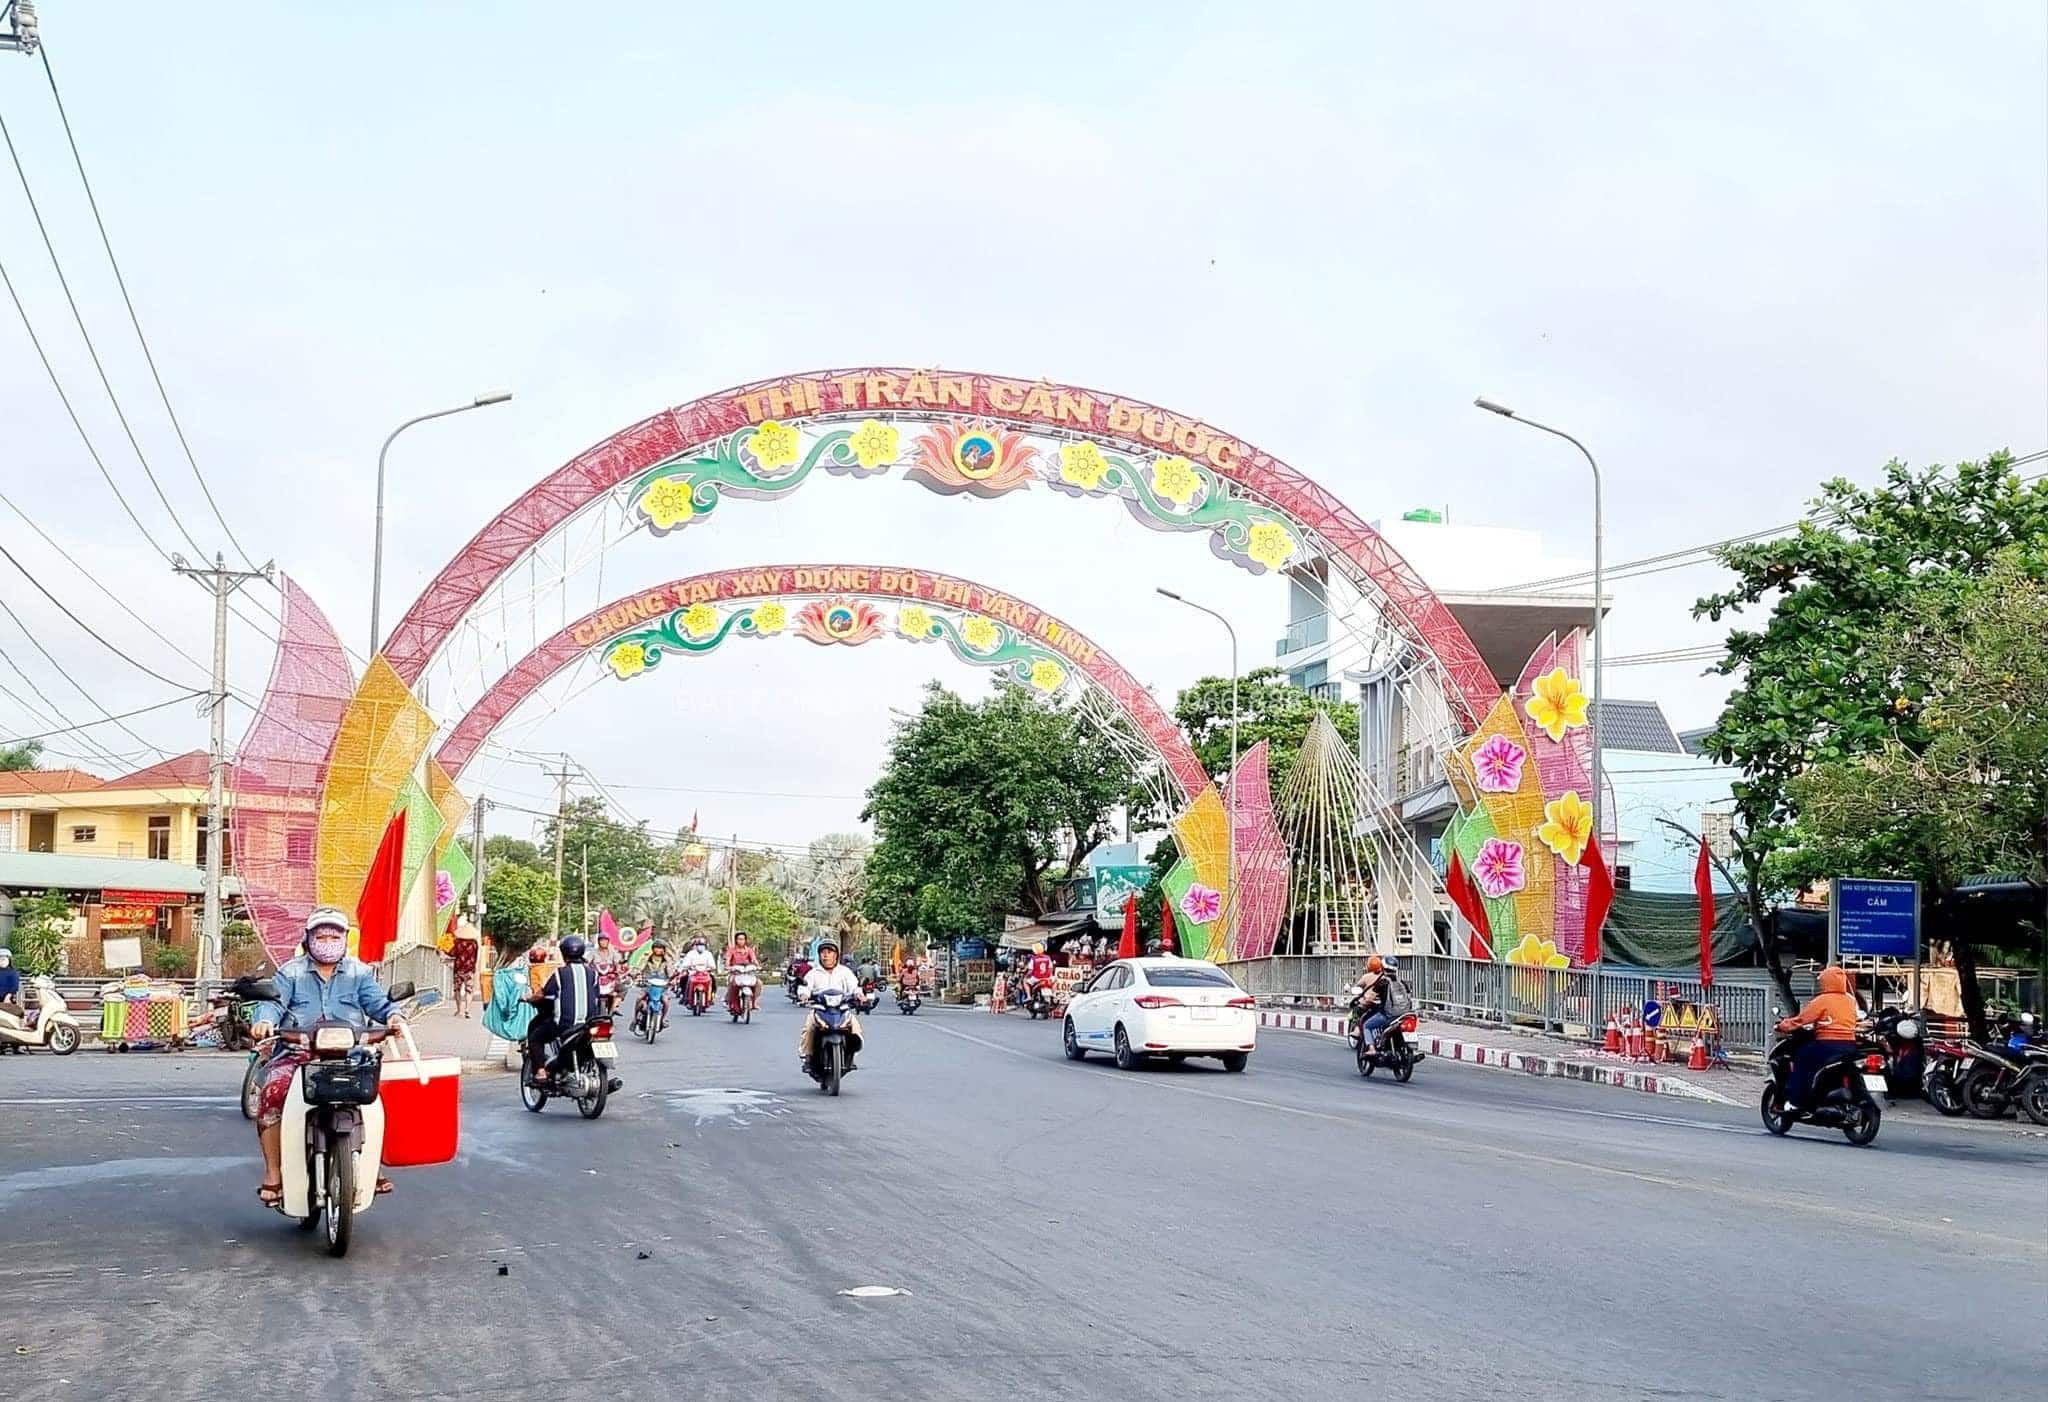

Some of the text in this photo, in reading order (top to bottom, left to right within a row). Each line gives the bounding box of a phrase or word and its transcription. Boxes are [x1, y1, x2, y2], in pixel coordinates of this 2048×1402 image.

[734, 379, 820, 424] THỊ
[830, 364, 973, 407] TRẤN
[987, 376, 1093, 423] CẦN
[572, 595, 669, 646] CHUNG
[671, 578, 722, 605] TAY
[732, 569, 784, 596] XÂY
[1031, 615, 1098, 665] MINH
